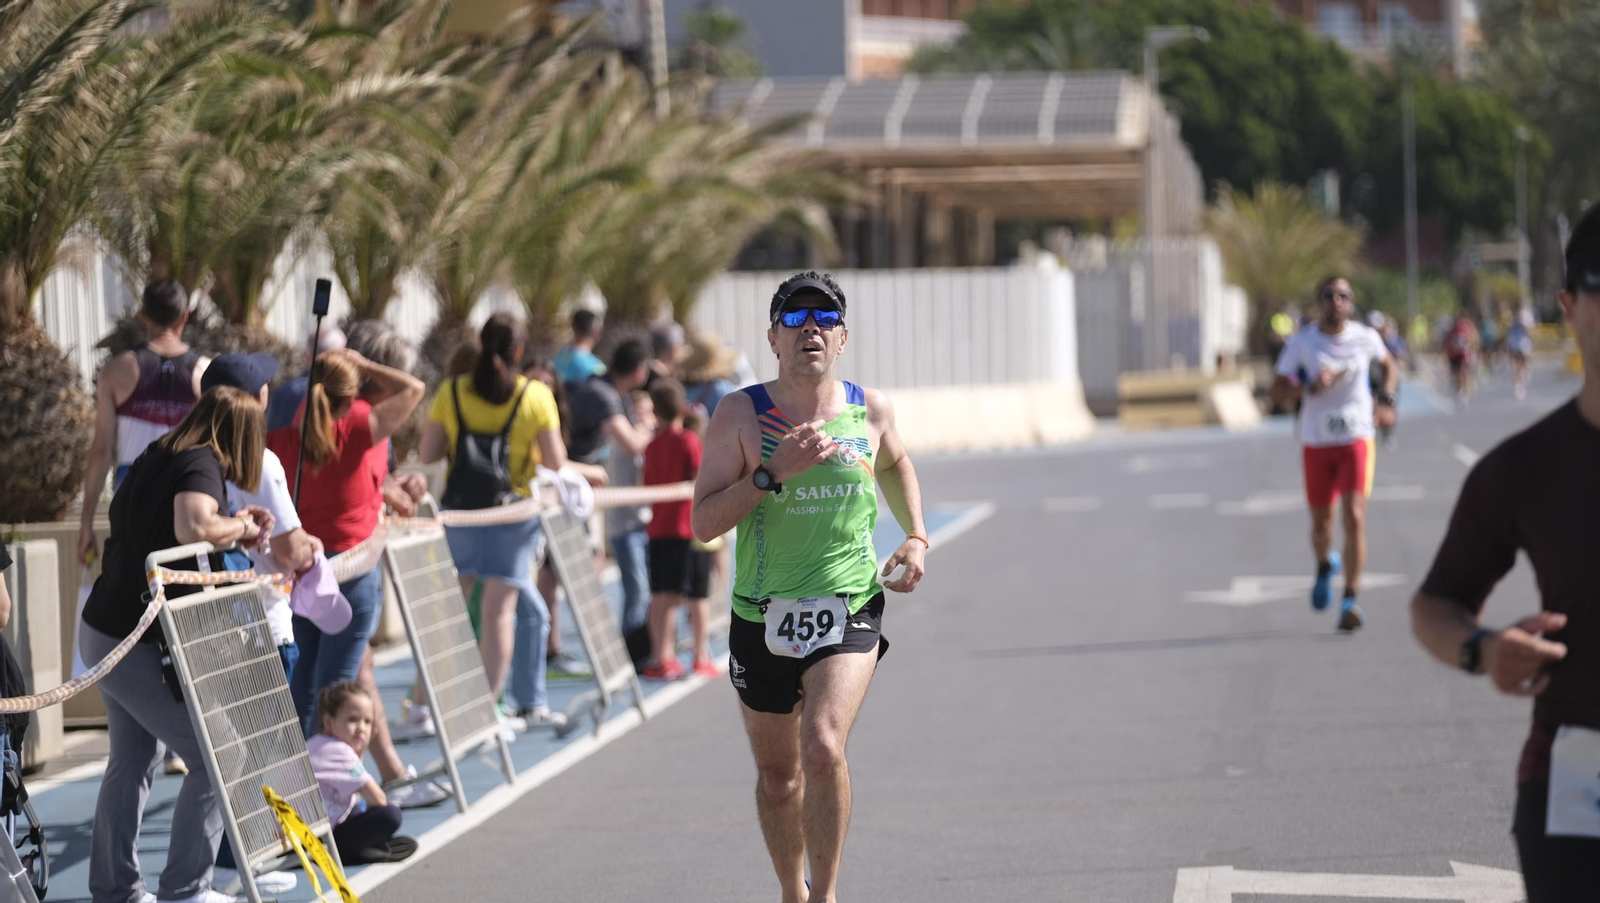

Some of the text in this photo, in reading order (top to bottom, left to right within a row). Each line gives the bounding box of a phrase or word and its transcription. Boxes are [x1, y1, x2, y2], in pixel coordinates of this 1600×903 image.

[795, 483, 864, 500] SAKATA
[826, 504, 833, 512] in
[777, 609, 834, 642] 459
